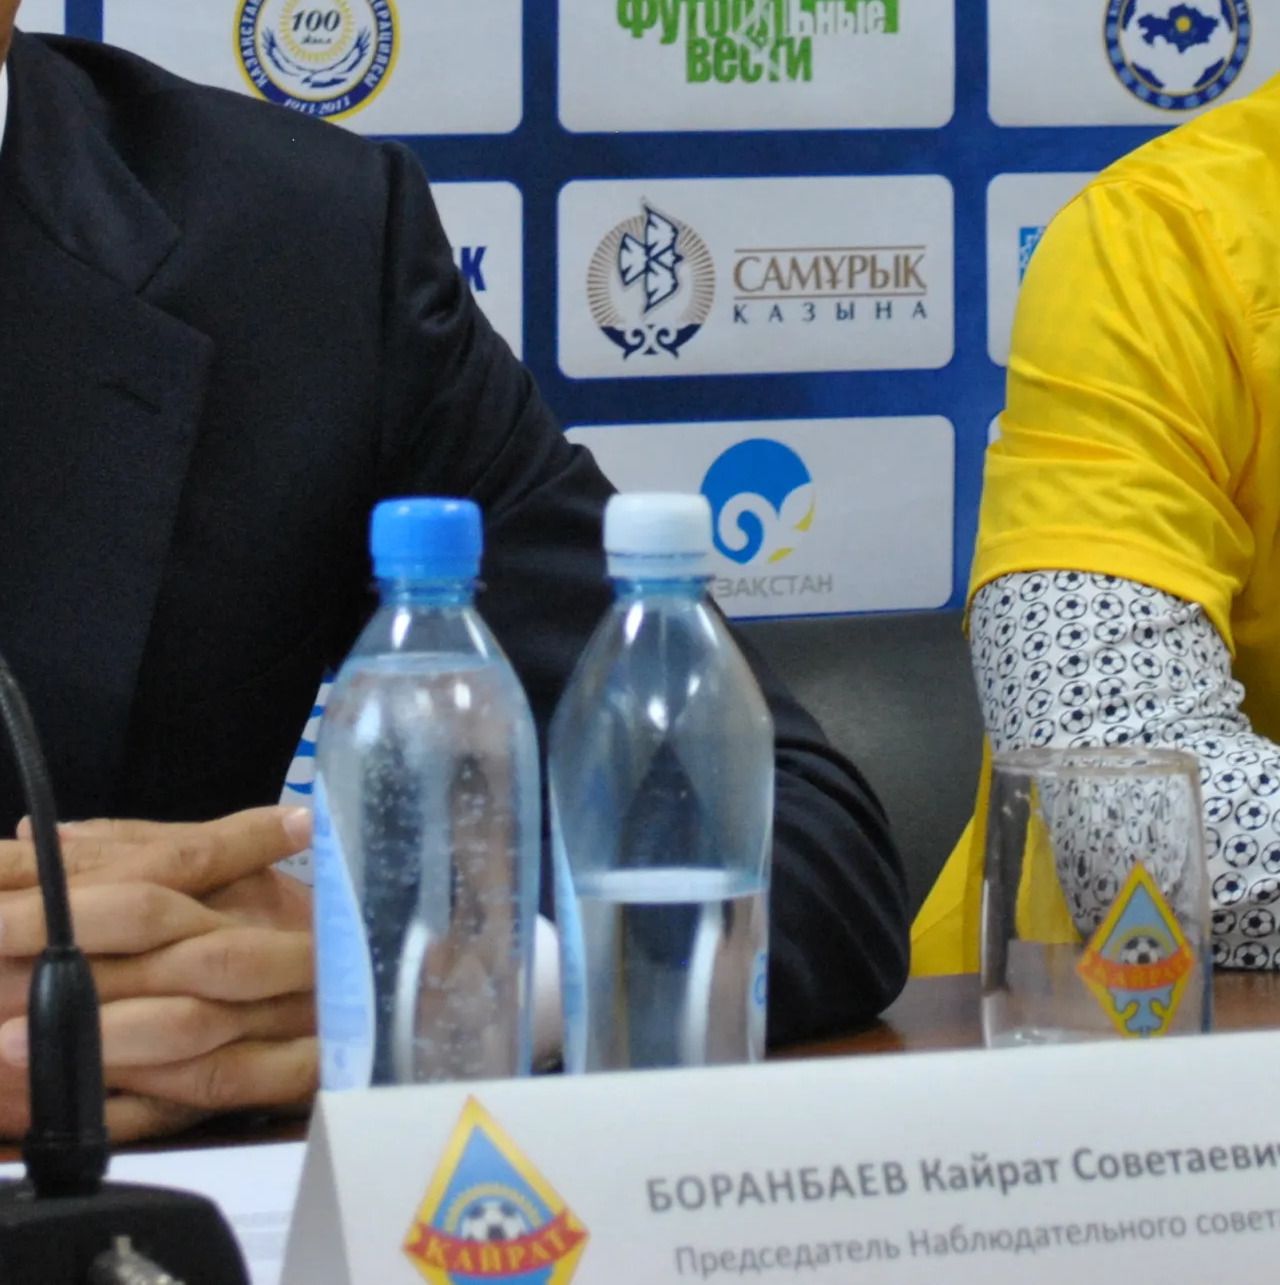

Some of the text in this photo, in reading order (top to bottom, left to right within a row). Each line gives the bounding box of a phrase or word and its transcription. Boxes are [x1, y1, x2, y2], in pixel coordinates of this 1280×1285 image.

[292, 9, 341, 32] 100
[733, 300, 928, 324] КАЗЫНА
[645, 1161, 908, 1213] БОРАНБАЕВ
[919, 1151, 1061, 1195] Кайрат
[674, 1236, 900, 1280] Председатель
[909, 1213, 1187, 1257] Наблюдательного
